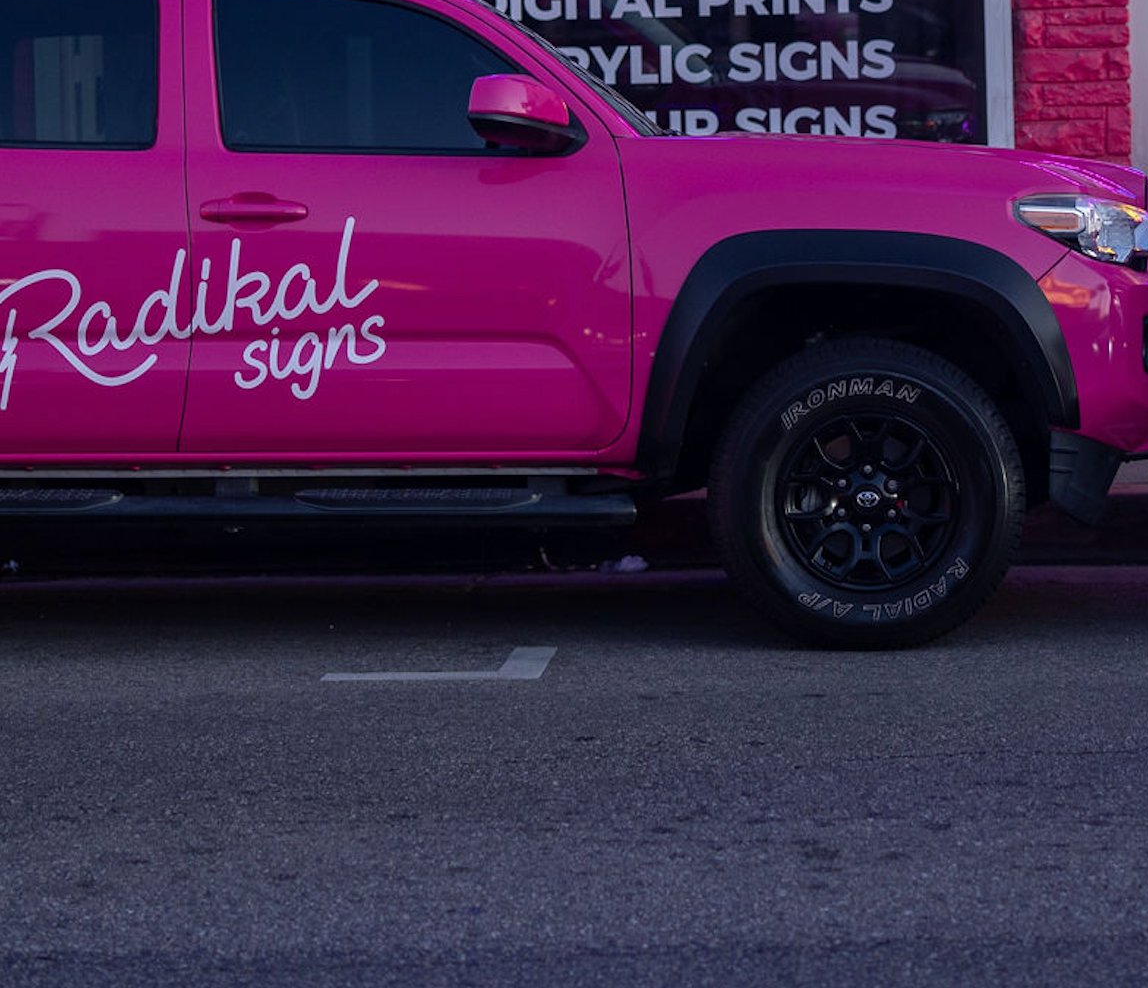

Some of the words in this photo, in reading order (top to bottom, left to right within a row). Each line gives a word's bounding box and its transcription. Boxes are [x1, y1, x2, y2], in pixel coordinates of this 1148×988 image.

[558, 44, 712, 85] YLIC
[728, 39, 896, 82] SIGNS
[736, 105, 897, 139] SIGNS
[0, 216, 379, 410] Radikal
[234, 315, 387, 400] signs
[780, 378, 921, 430] IRONMAN
[797, 592, 854, 618] A/P
[862, 557, 970, 621] RADIAL
